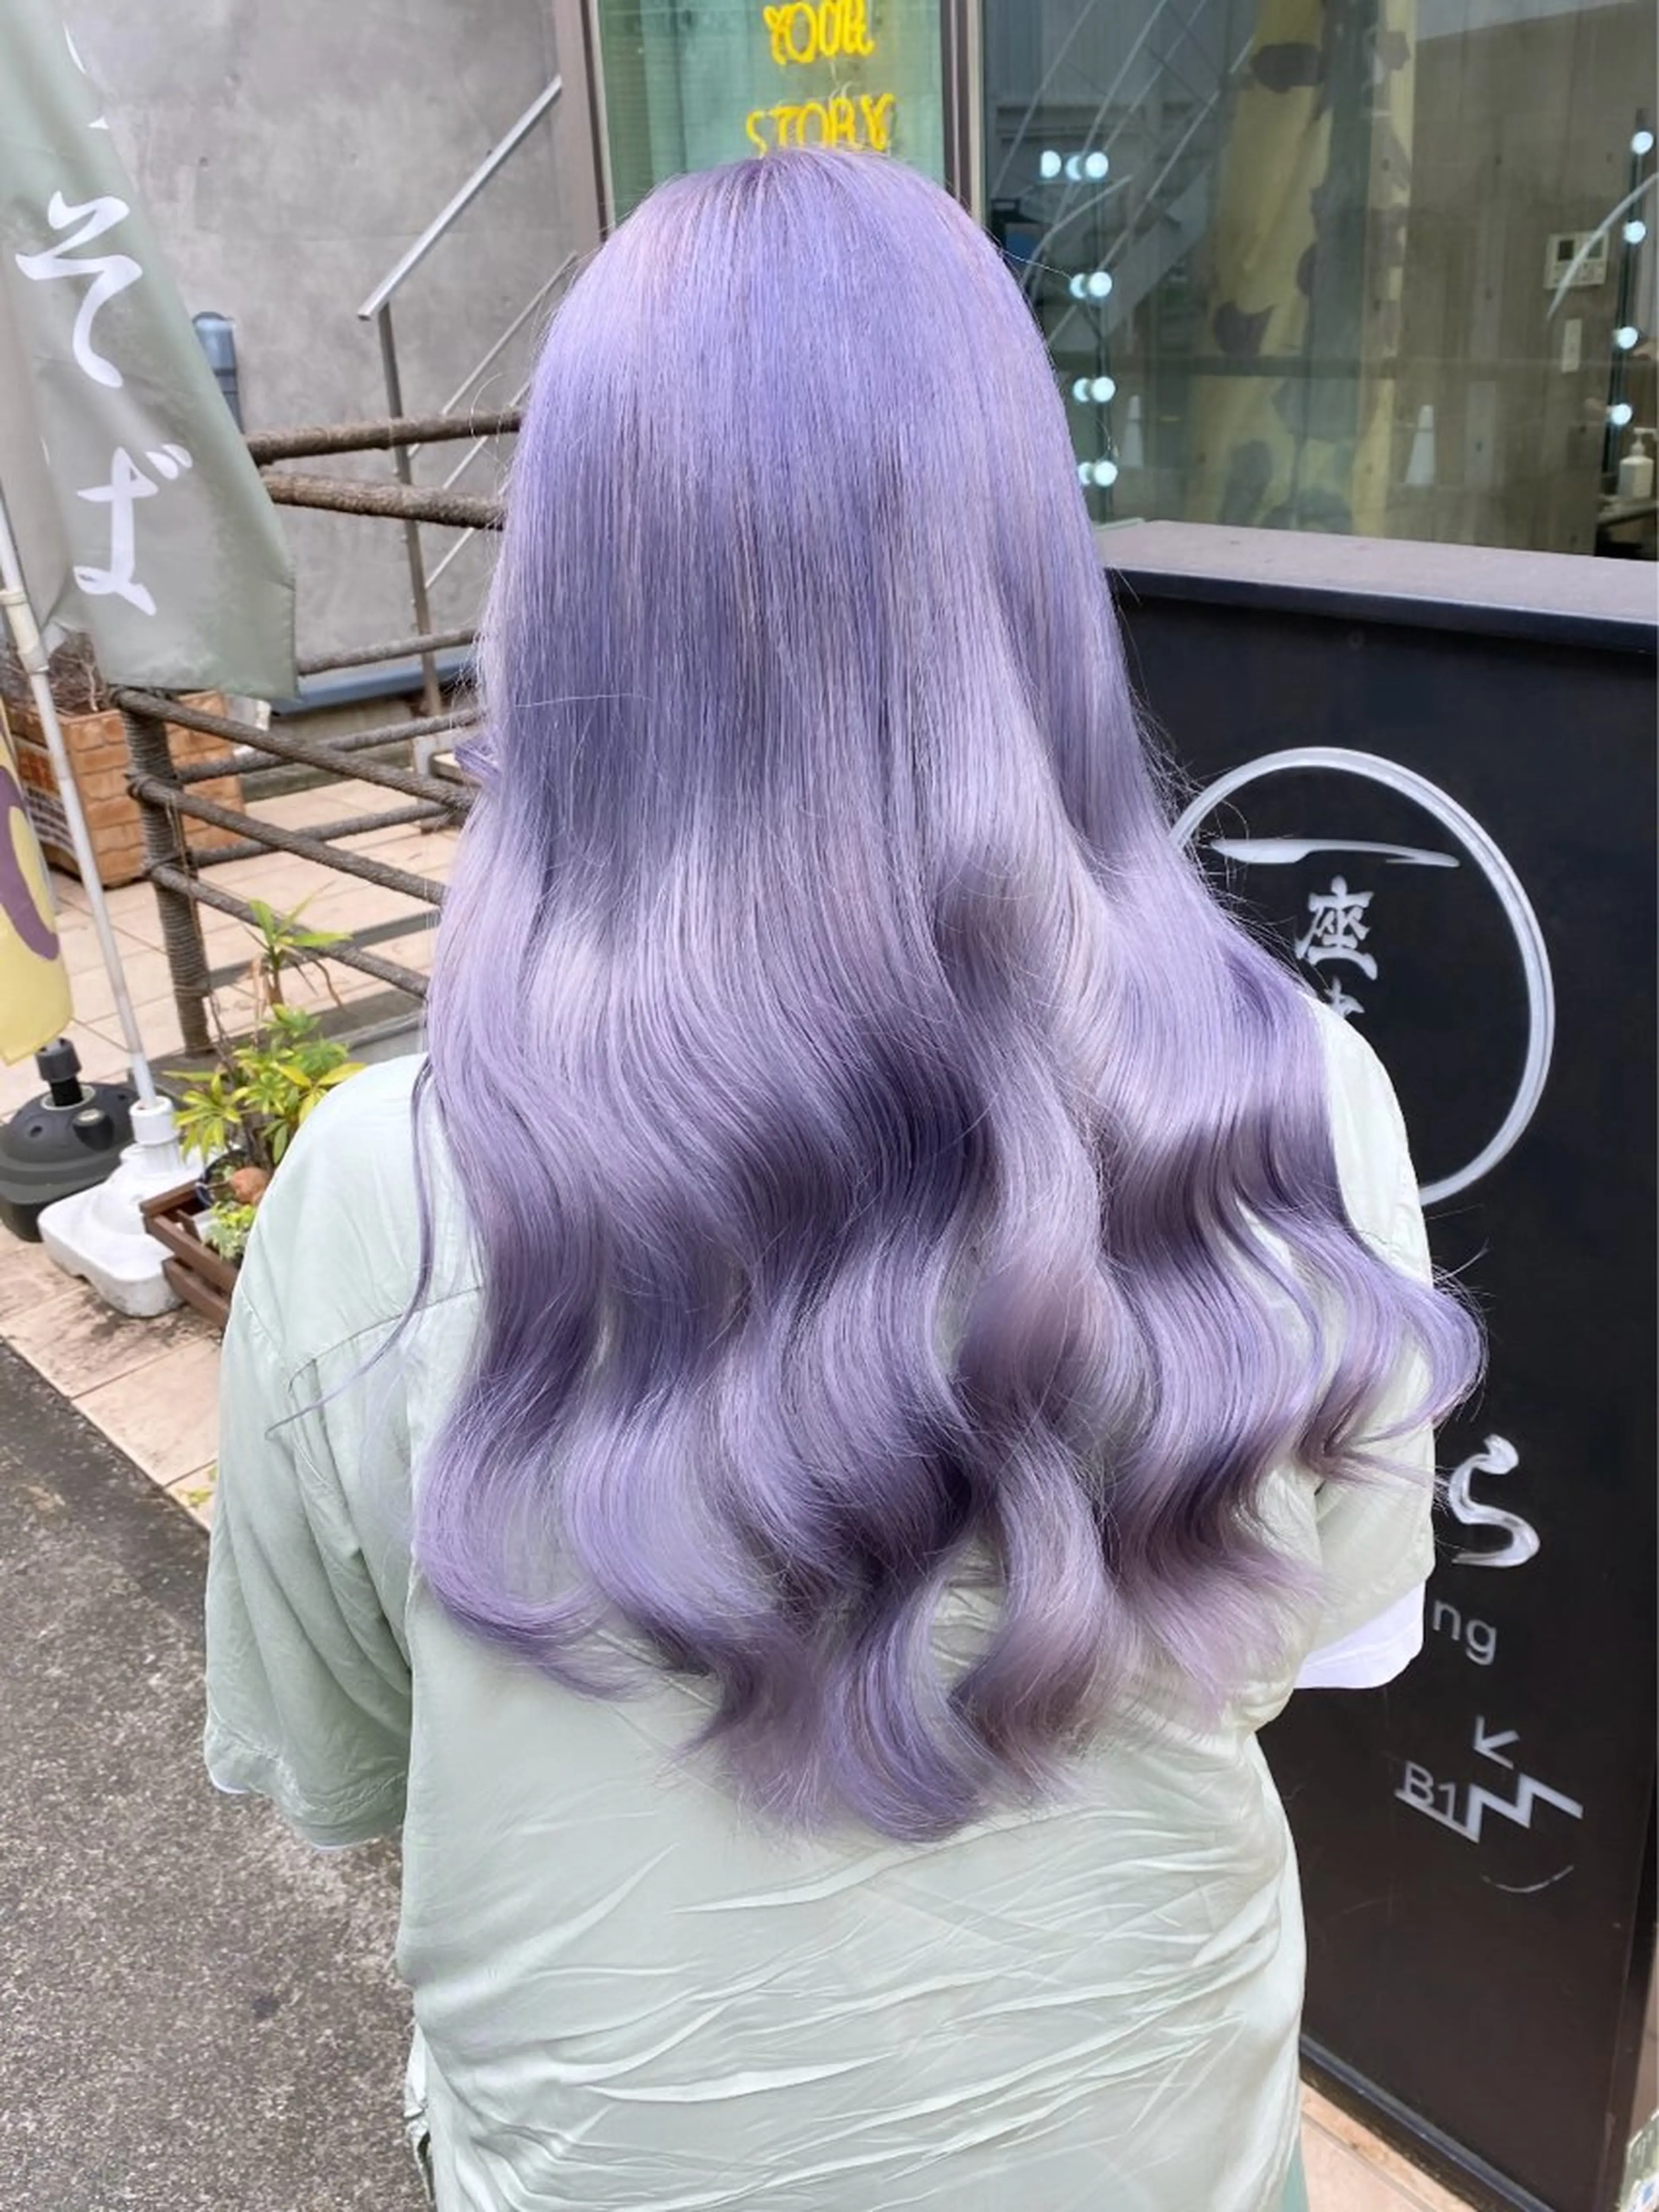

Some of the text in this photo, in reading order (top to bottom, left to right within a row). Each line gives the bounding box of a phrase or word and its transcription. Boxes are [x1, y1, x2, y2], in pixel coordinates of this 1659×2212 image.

[763, 0, 874, 66] YOUR
[746, 93, 895, 161] STORY
[1404, 1760, 1456, 1820] B1
